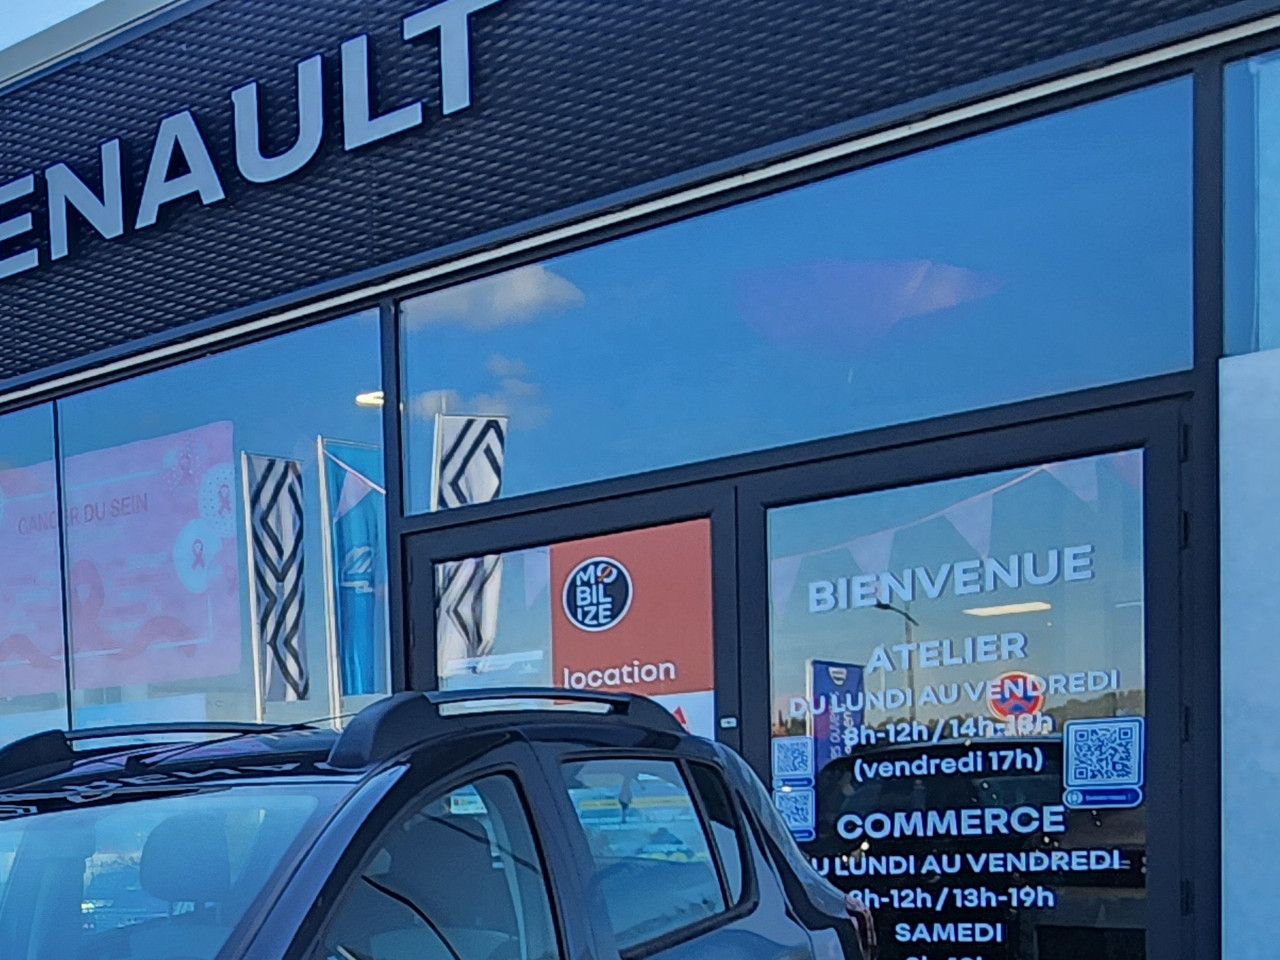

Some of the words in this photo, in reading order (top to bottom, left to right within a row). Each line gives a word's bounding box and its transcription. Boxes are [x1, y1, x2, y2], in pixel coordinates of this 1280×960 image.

[17, 506, 80, 536] CANCR
[83, 502, 106, 523] DU
[110, 493, 149, 518] SEIN
[808, 544, 1094, 613] BIENVENUE
[867, 631, 1028, 674] ATELIER
[563, 660, 676, 690] location
[789, 695, 826, 718] DU
[830, 688, 912, 713] LUNDI
[919, 683, 959, 706] AU
[964, 669, 1120, 702] VENDREDI
[845, 721, 928, 746] 8h-12h
[853, 751, 983, 782] (vendredi
[989, 748, 1045, 772] 17h)
[836, 804, 1066, 840] COMMERCE
[811, 857, 829, 876] U
[835, 855, 915, 876] LUNDI
[921, 853, 961, 874] AU
[966, 849, 1120, 873] VENDREDI
[953, 885, 1055, 908] 13h-19h
[894, 922, 1003, 943] SAMEDI
